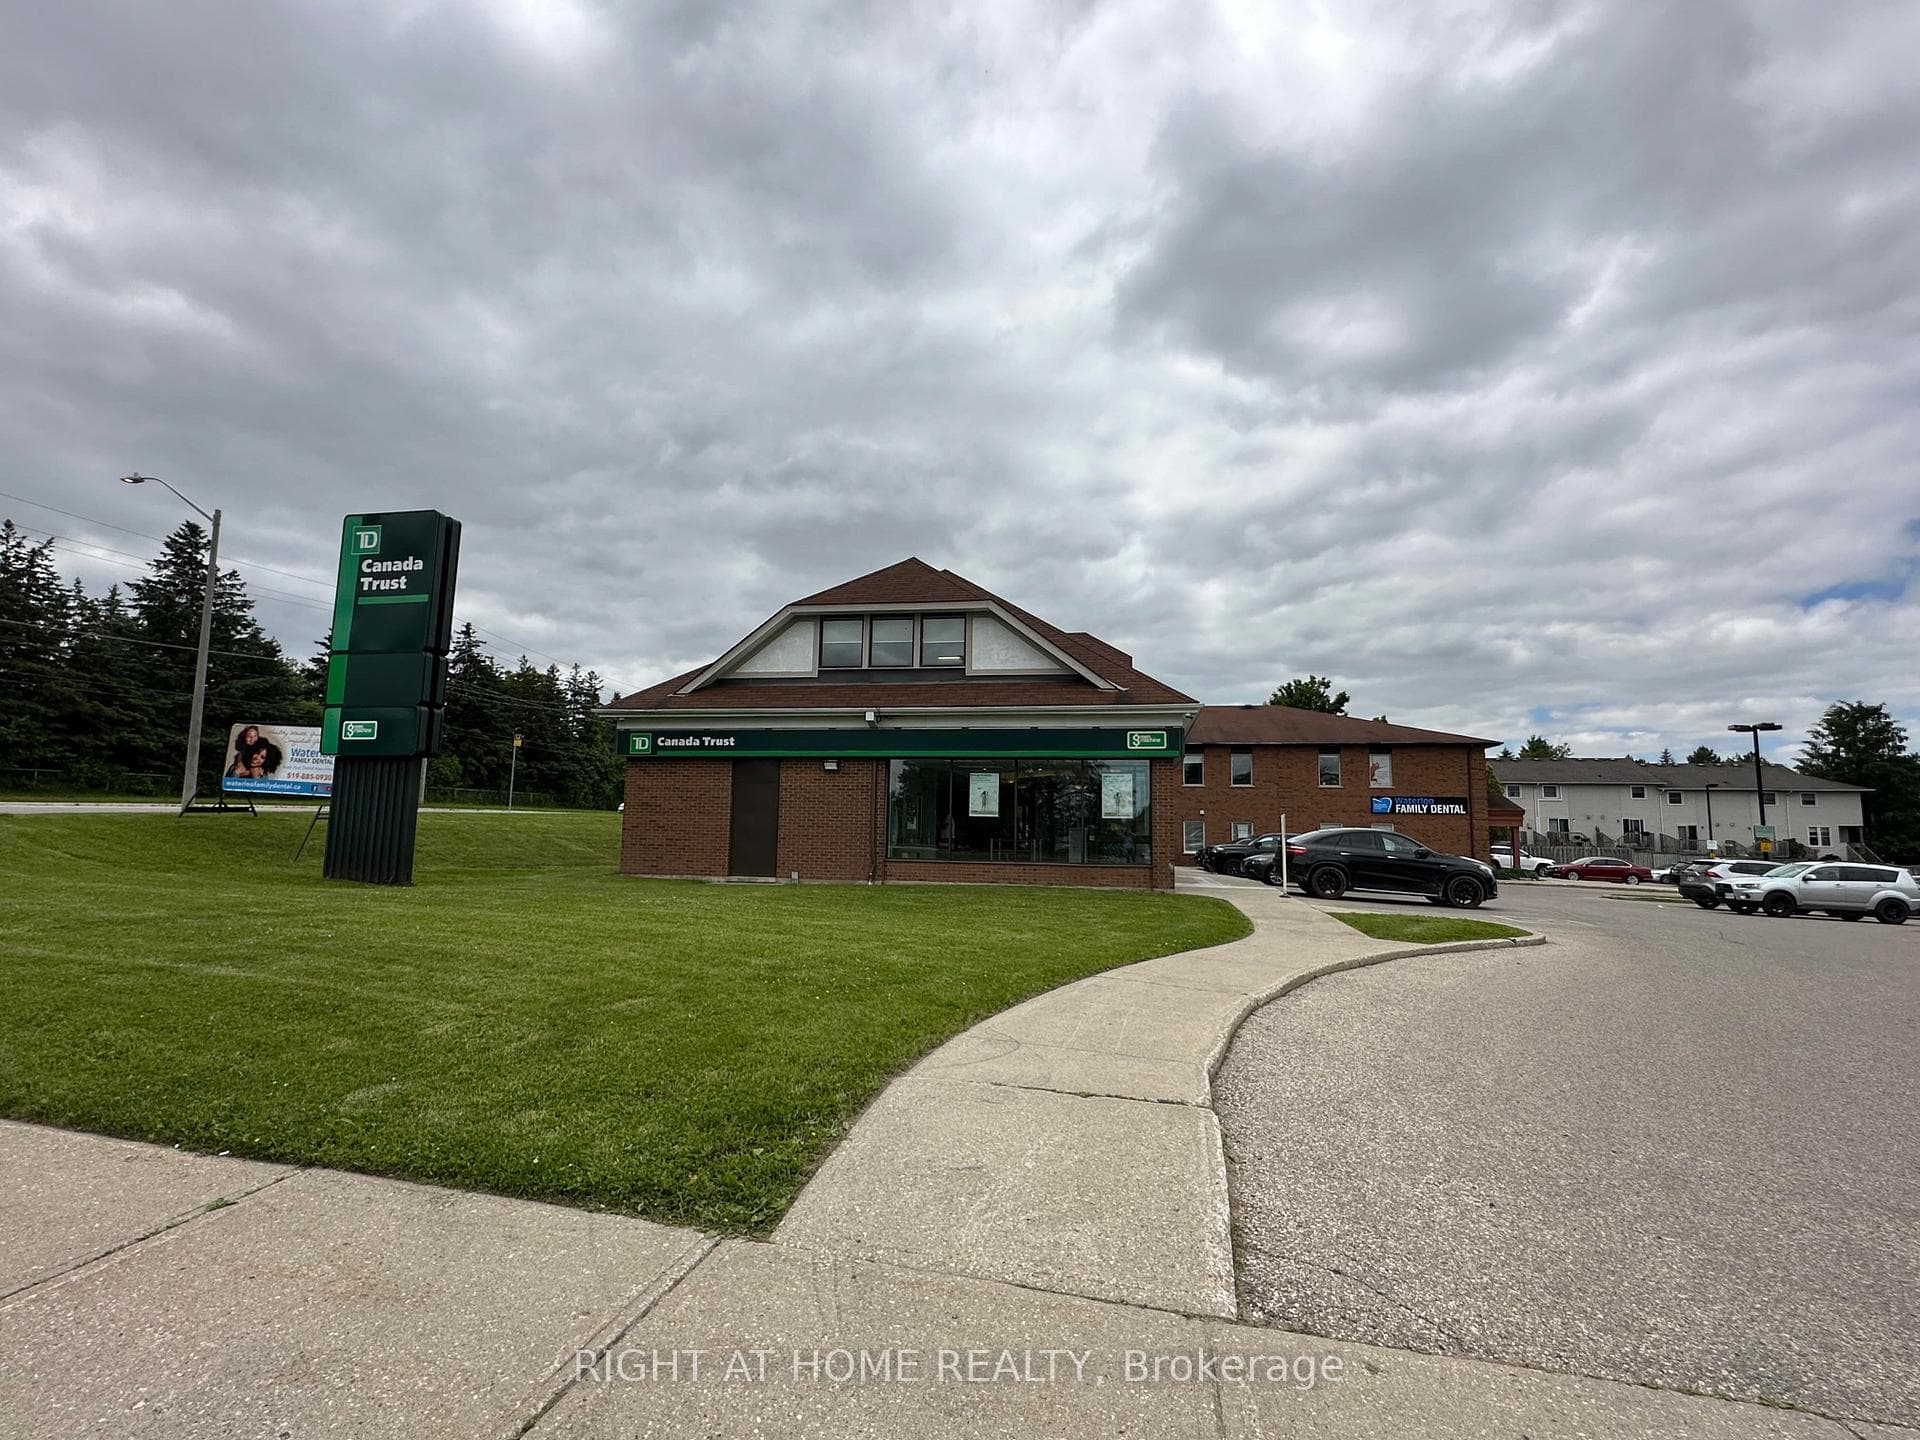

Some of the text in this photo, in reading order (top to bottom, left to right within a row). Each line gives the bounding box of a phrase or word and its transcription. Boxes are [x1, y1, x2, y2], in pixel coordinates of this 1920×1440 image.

[355, 531, 378, 549] TD
[361, 556, 424, 573] Canada
[360, 575, 407, 591] Trust
[632, 737, 649, 750] TD
[657, 736, 736, 747] Canada Trust
[1395, 804, 1467, 814] FAMILY DENTAL
